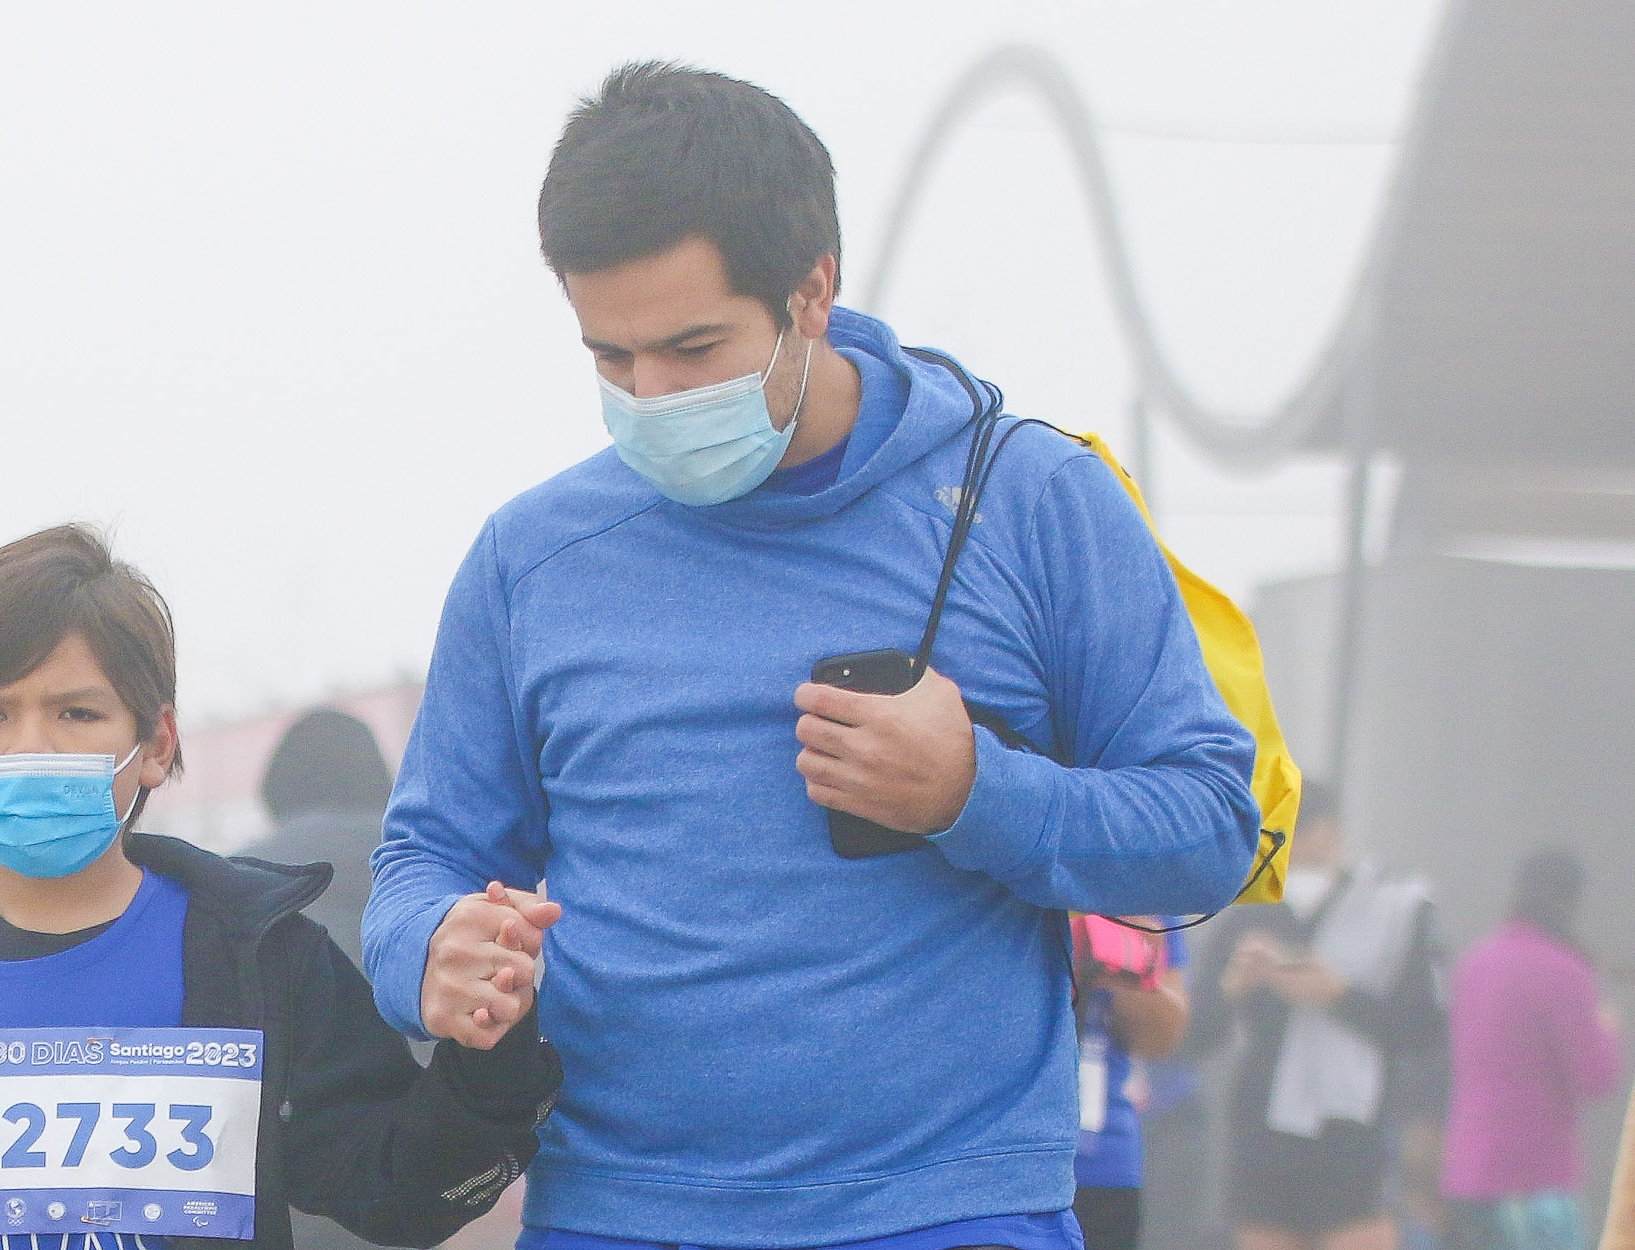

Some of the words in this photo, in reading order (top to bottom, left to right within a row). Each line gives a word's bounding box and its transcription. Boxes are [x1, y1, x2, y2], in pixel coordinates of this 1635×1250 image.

[31, 1041, 104, 1065] DIAS
[109, 1042, 185, 1059] Santiago
[186, 1041, 257, 1067] 2023
[0, 1102, 215, 1170] 2733
